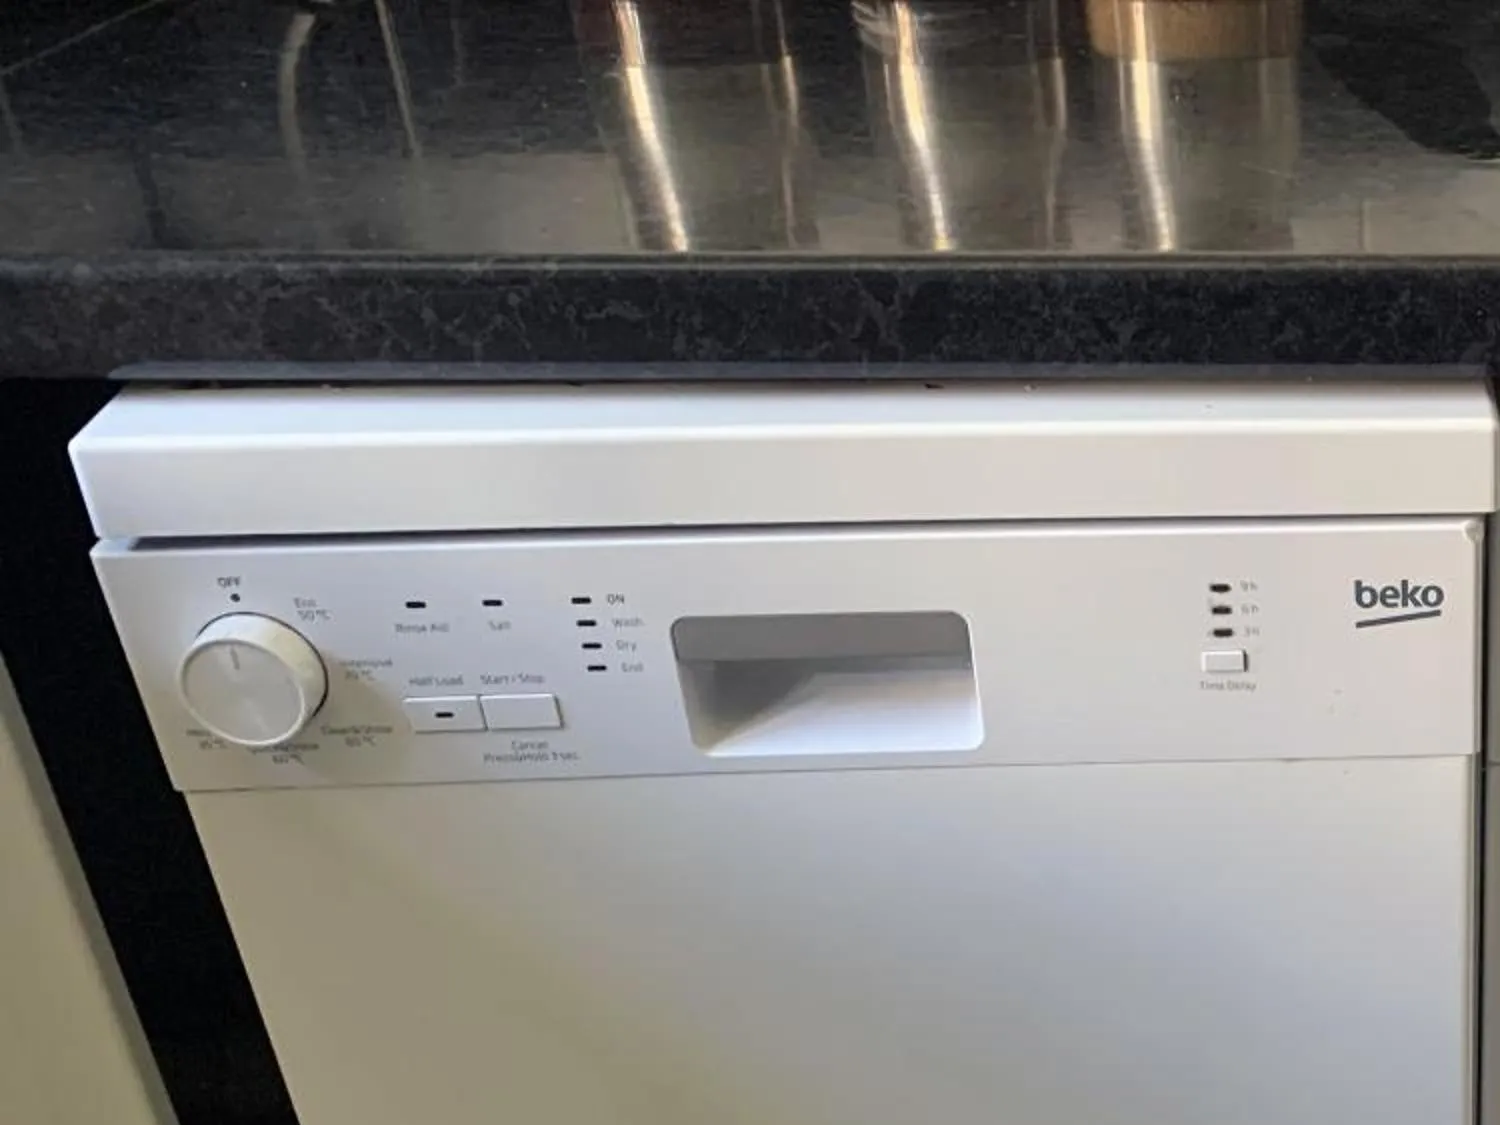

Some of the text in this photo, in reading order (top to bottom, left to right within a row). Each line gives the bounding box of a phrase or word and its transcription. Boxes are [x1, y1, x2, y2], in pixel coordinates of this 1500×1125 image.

[217, 576, 241, 588] OFF
[606, 593, 625, 605] ON
[1354, 579, 1445, 608] beko
[480, 673, 509, 686] Start
